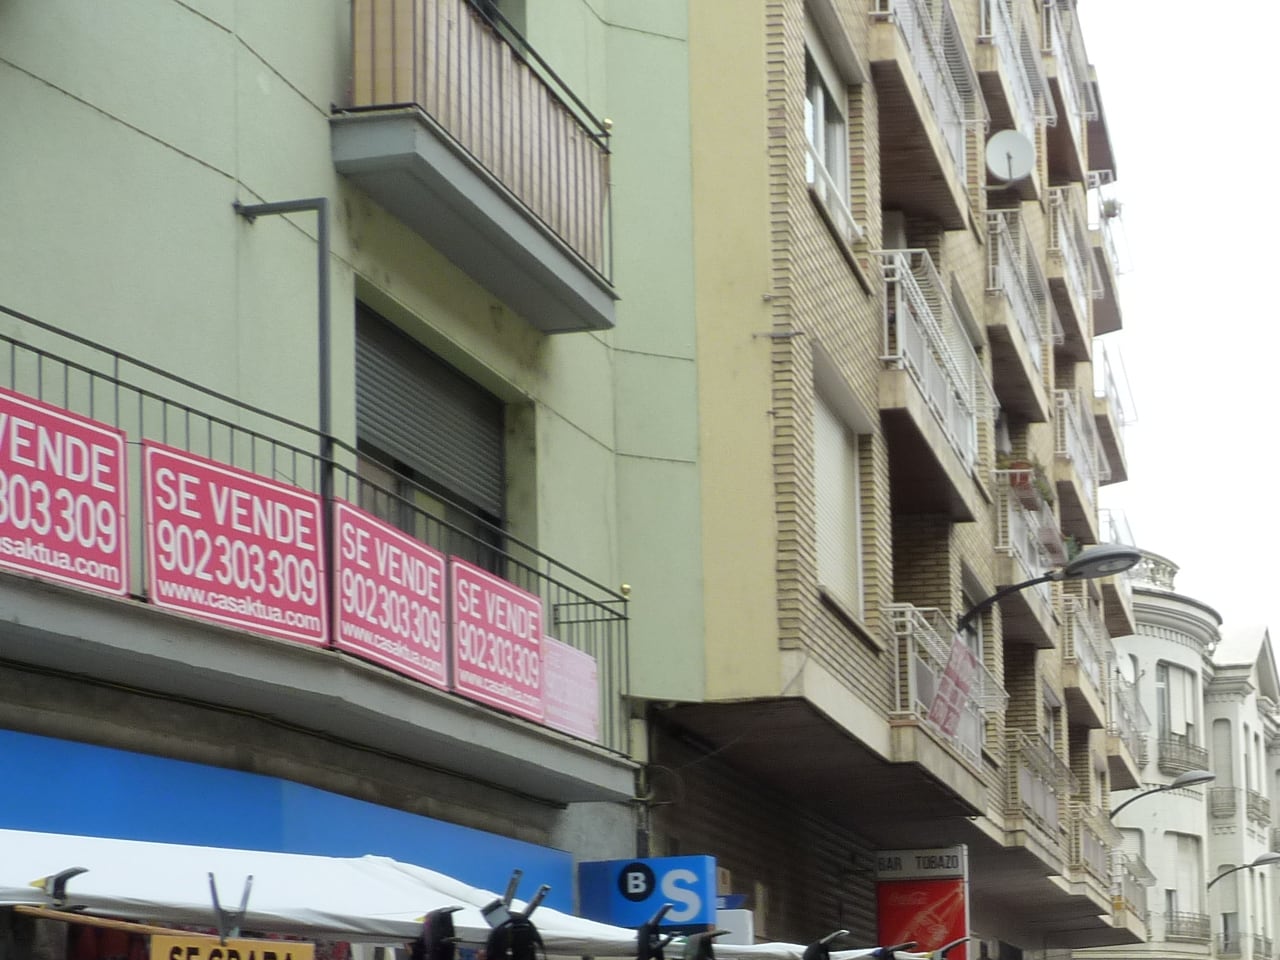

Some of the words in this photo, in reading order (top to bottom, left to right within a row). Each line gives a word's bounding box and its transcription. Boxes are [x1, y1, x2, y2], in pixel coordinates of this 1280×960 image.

[155, 467, 202, 519] SE
[208, 482, 316, 551] VENDE
[0, 536, 120, 584] saktua.com
[341, 522, 371, 569] SE
[374, 537, 441, 604] VENDE
[157, 579, 321, 632] www.casaktua.com
[458, 579, 482, 619] SE
[484, 589, 540, 644] VENDE
